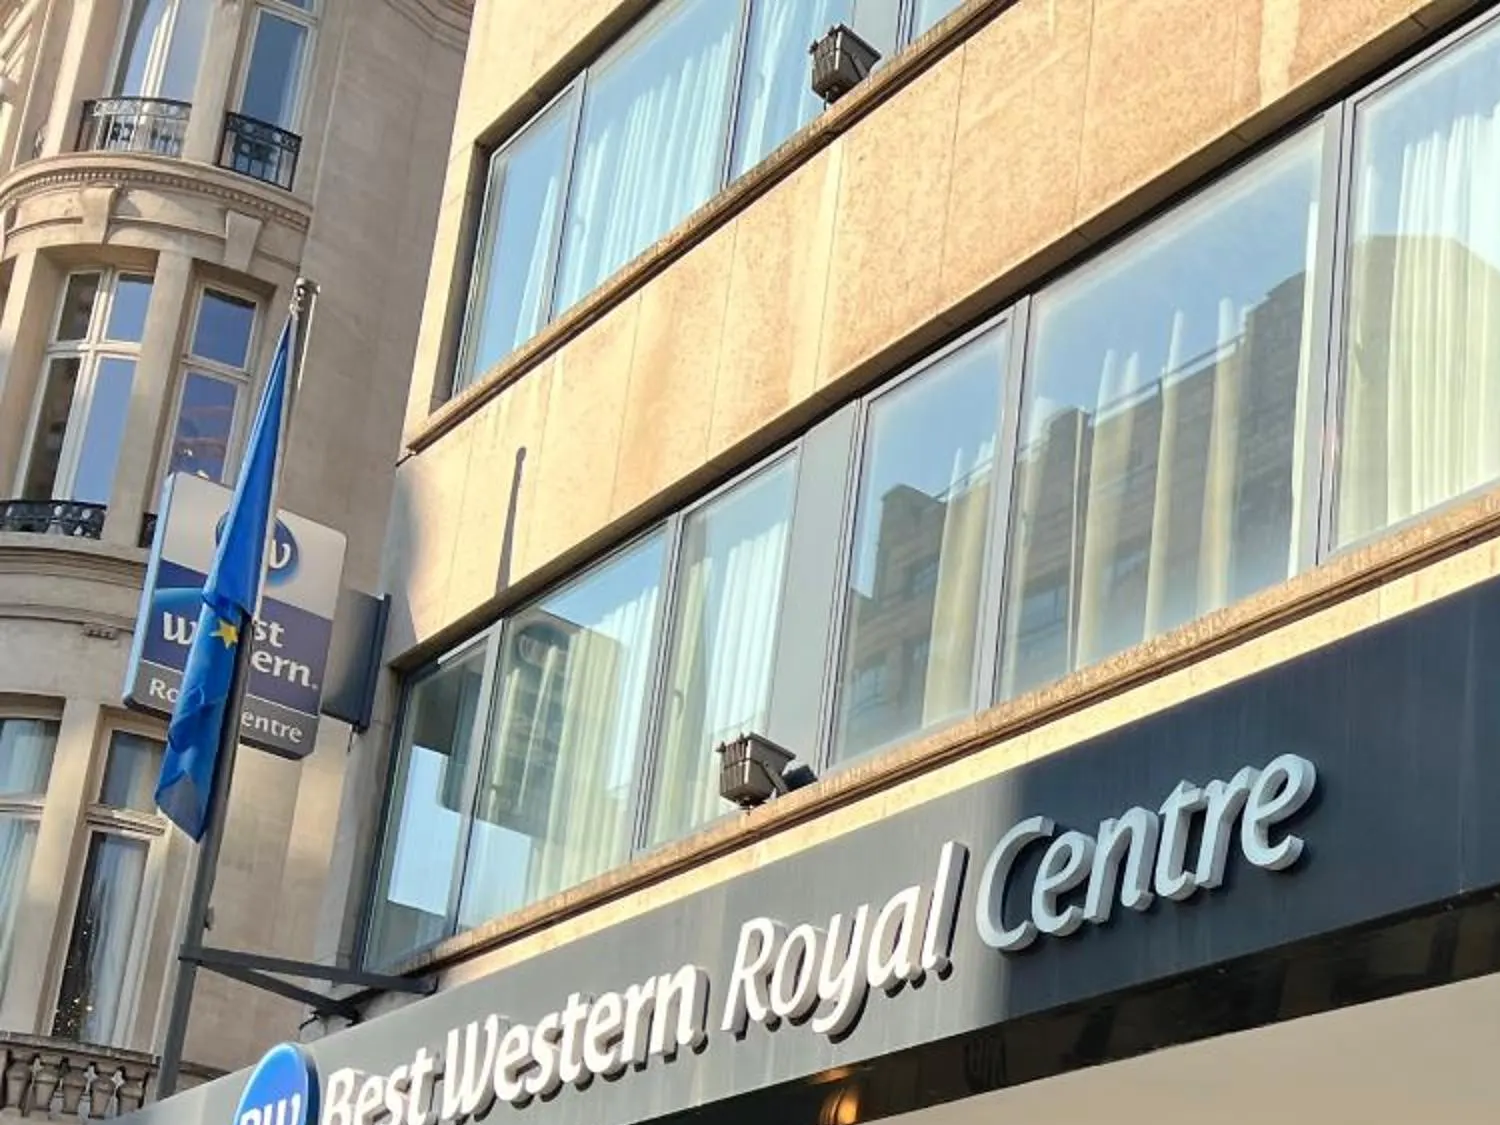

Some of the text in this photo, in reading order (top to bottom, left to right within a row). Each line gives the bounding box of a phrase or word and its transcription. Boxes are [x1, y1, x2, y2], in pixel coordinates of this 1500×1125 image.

[241, 709, 302, 743] entre
[438, 963, 706, 1125] Western
[720, 840, 970, 1038] Royal
[976, 752, 1317, 952] Centre
